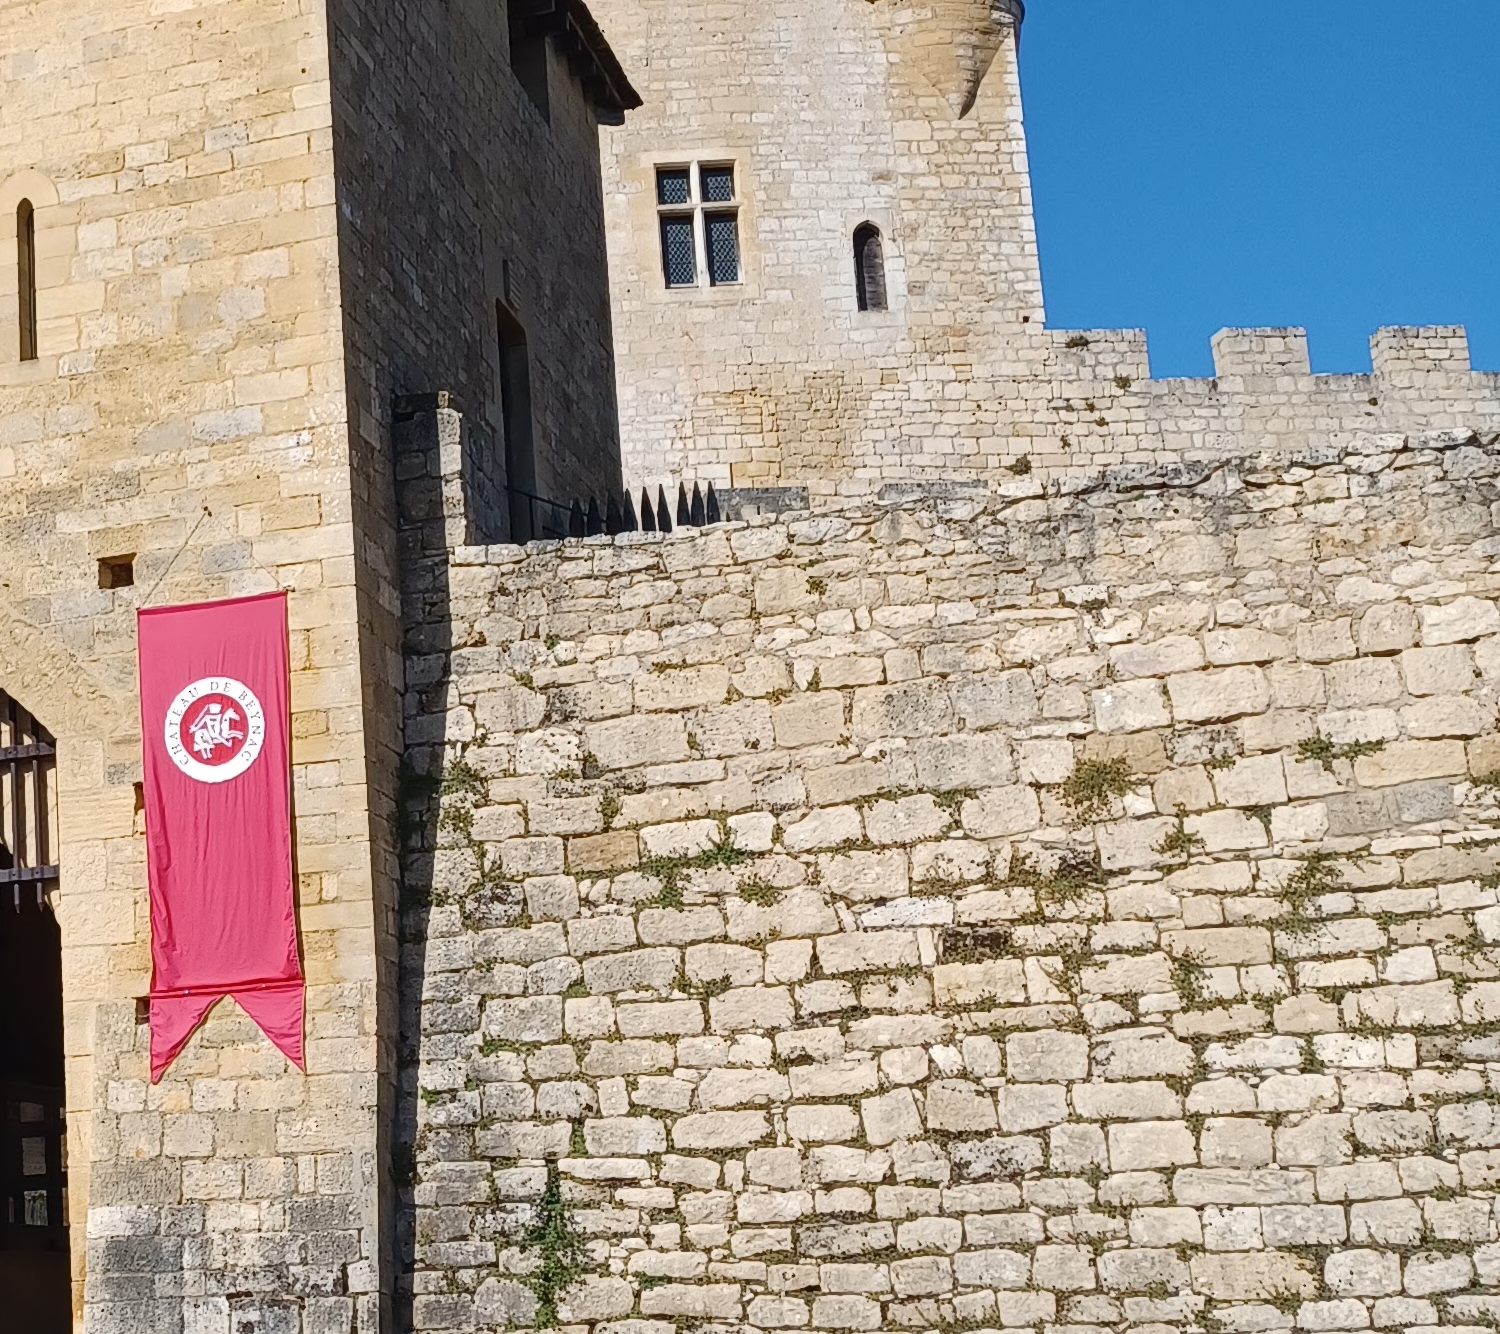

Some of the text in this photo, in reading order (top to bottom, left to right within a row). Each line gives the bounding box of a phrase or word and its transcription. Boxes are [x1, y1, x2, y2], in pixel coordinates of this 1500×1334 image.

[169, 681, 261, 765] CHATEAU DE BEYNAC
